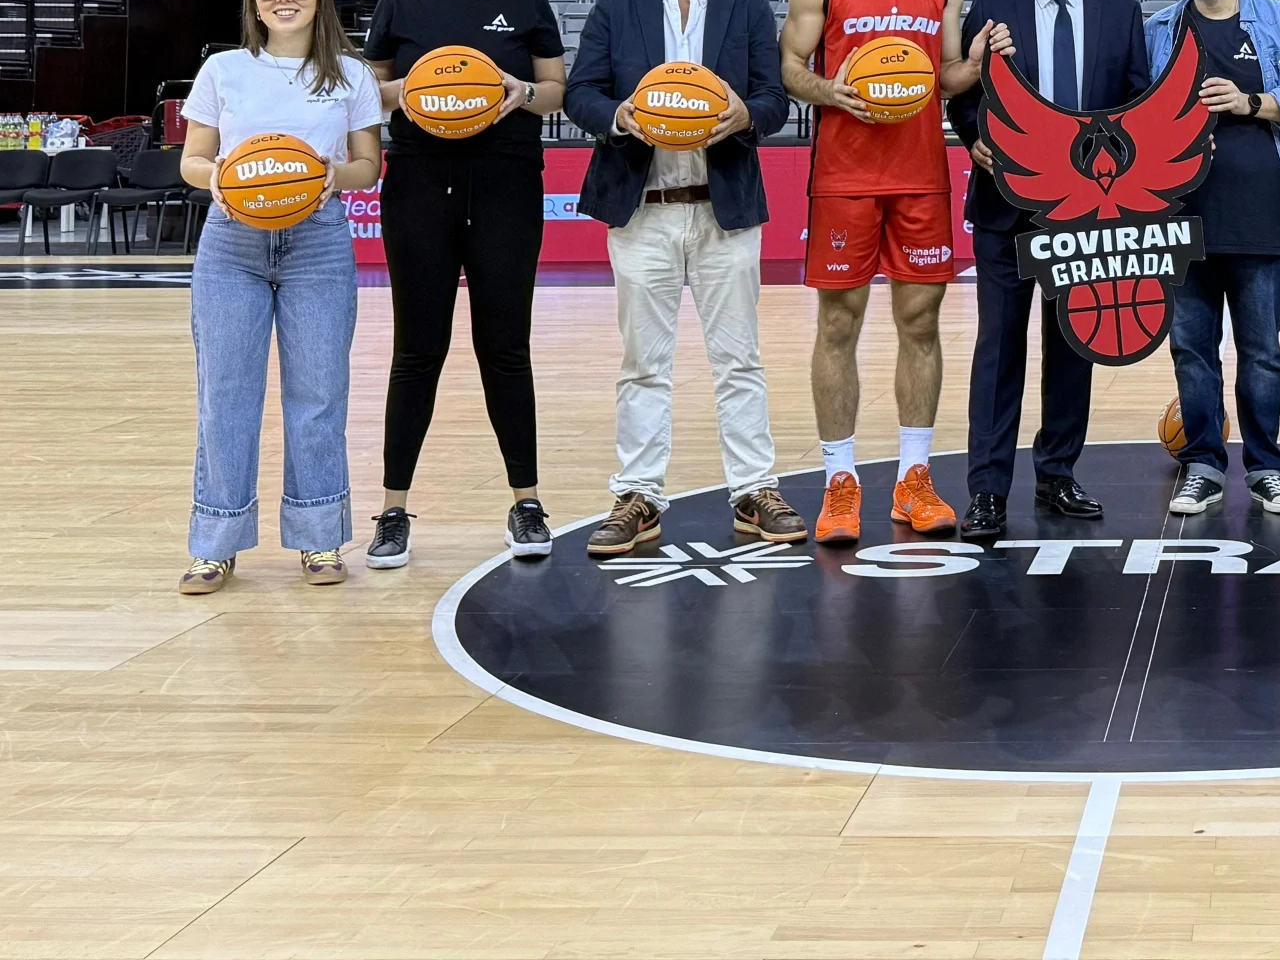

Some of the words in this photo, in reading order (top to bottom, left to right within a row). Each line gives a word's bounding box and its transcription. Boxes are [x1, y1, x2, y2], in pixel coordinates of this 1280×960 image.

[880, 52, 906, 65] acb
[434, 64, 463, 76] acb
[665, 66, 693, 76] acb
[867, 82, 927, 98] Wilson
[419, 94, 488, 112] Wilson
[647, 91, 710, 112] Wilson
[250, 134, 280, 145] acb
[235, 157, 308, 181] Wilson
[341, 195, 381, 216] dea
[1030, 220, 1191, 260] COVIRAN
[902, 245, 940, 255] Granada
[826, 263, 850, 271] vive
[909, 254, 940, 266] Digital
[1051, 253, 1175, 288] GRANADA
